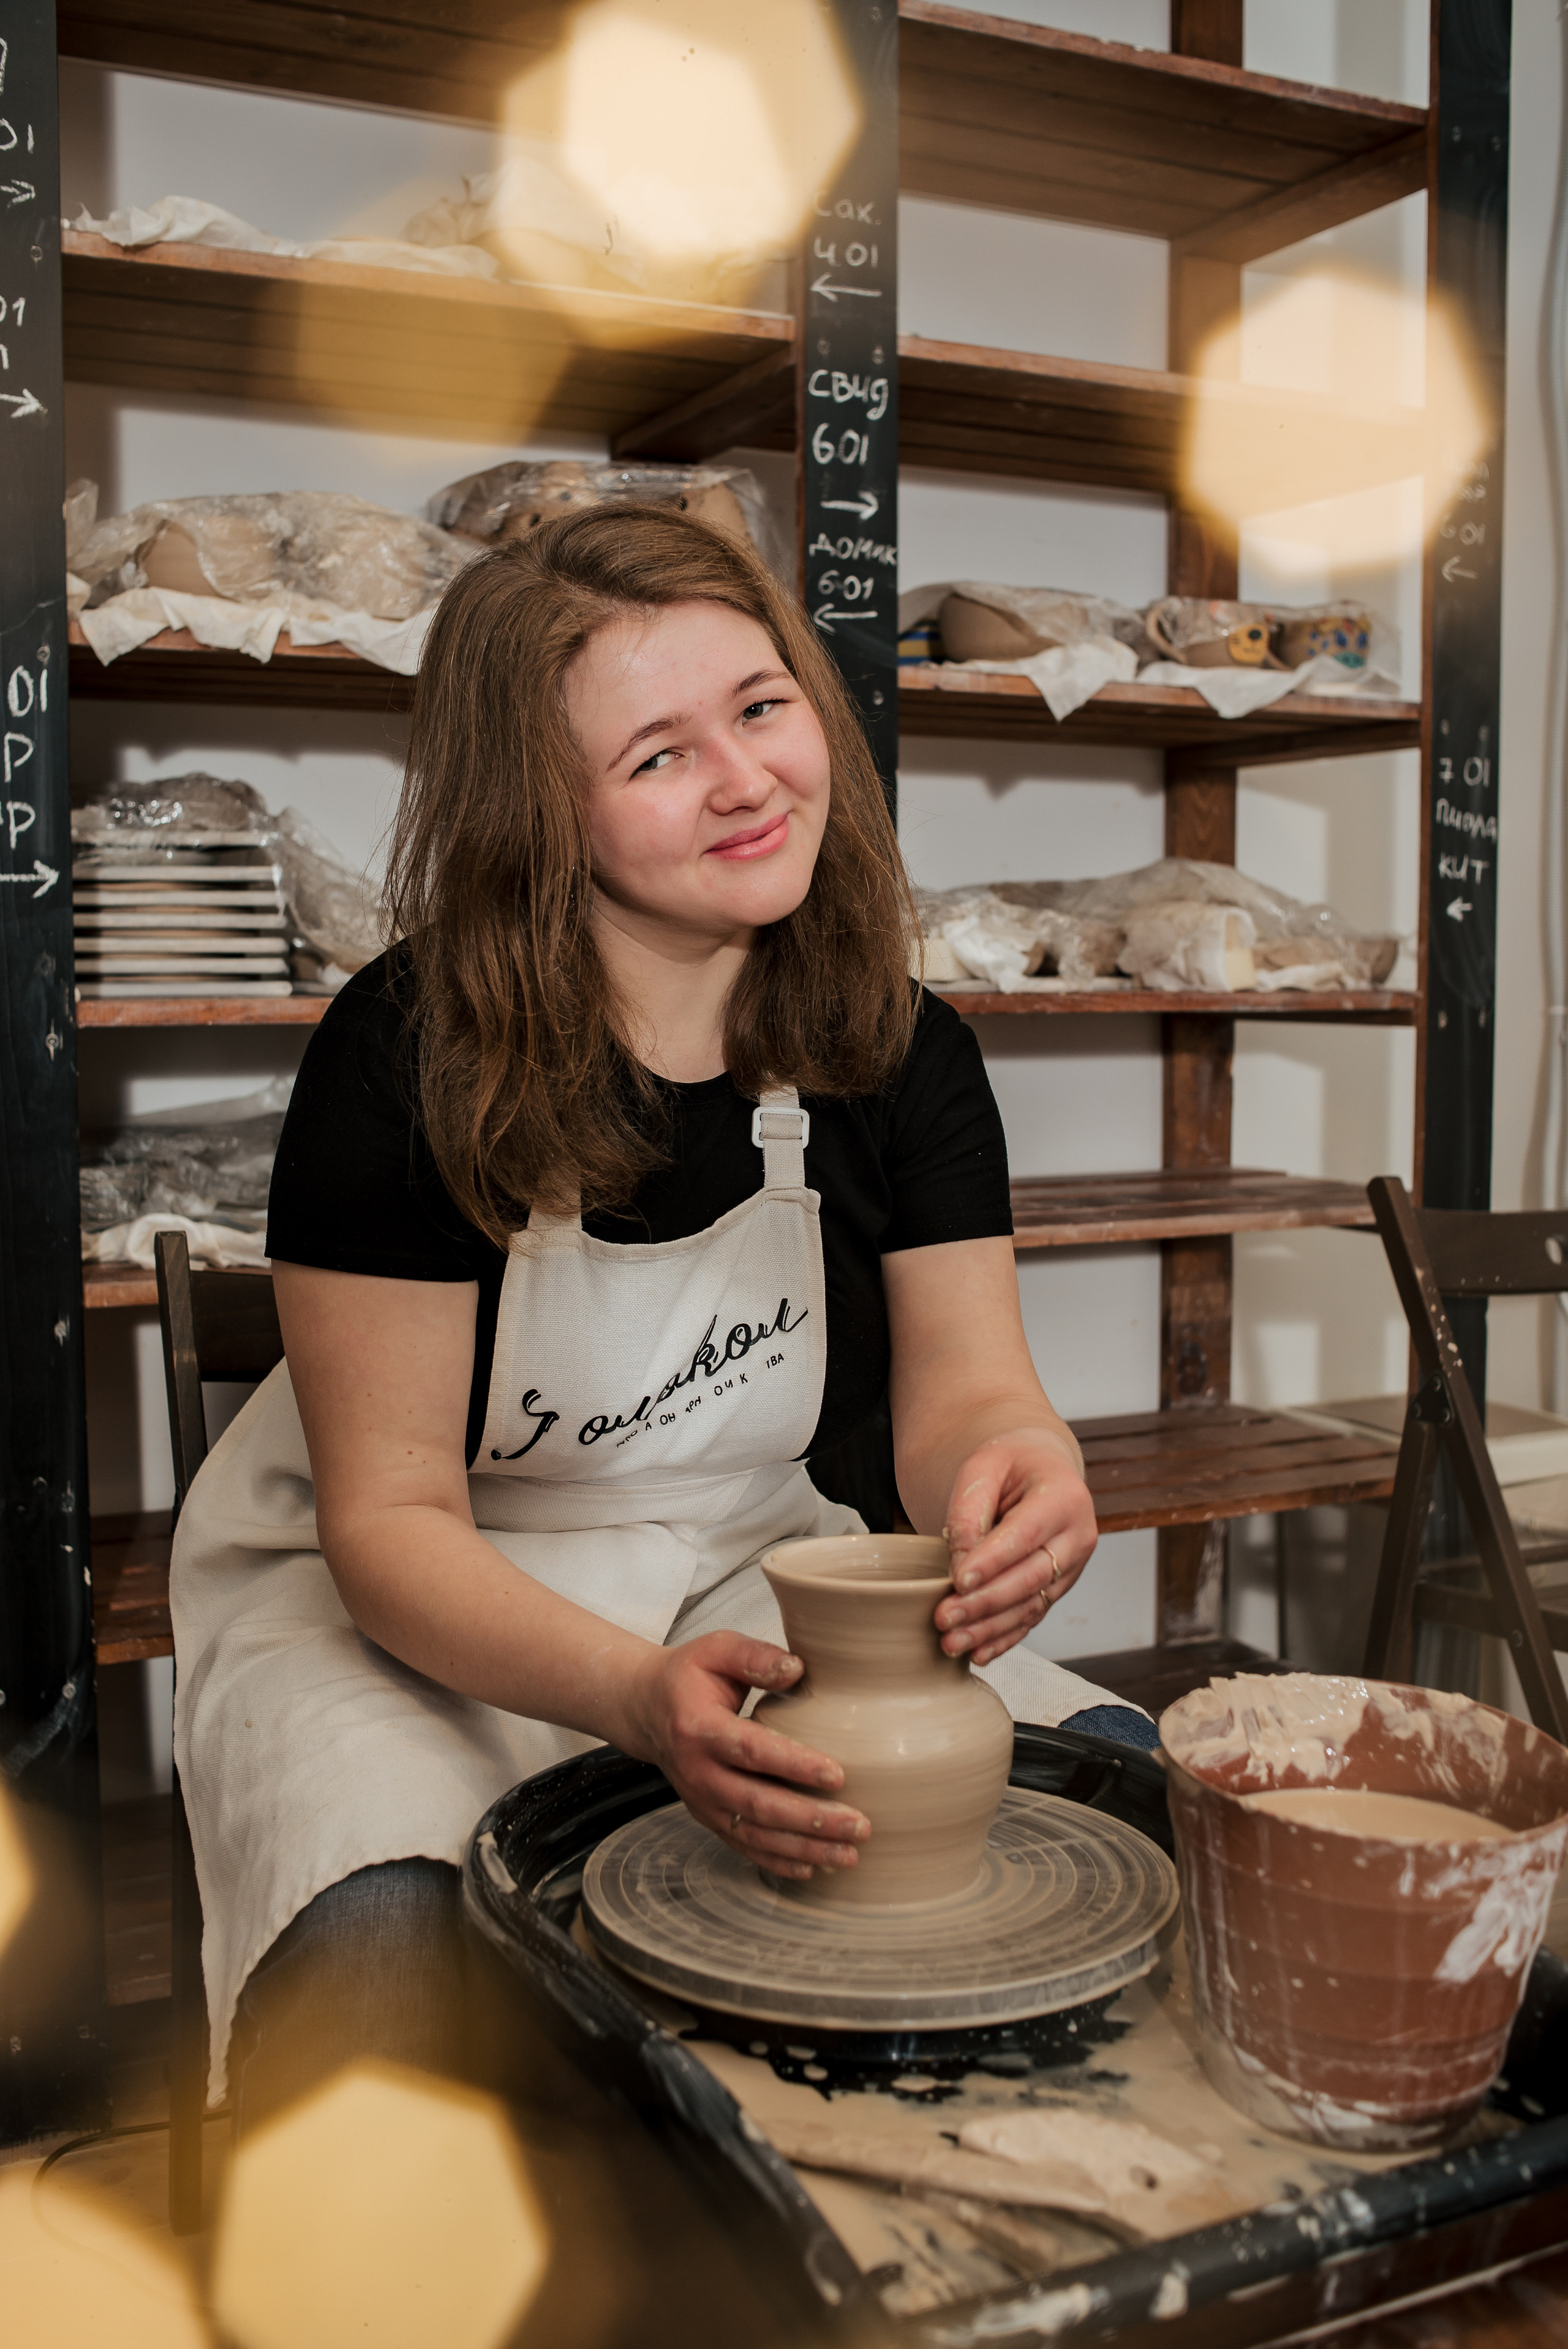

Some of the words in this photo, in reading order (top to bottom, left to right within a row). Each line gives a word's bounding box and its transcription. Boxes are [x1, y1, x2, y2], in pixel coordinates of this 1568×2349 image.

[813, 236, 878, 267] 401
[812, 423, 869, 466] 601
[818, 569, 875, 601] 601
